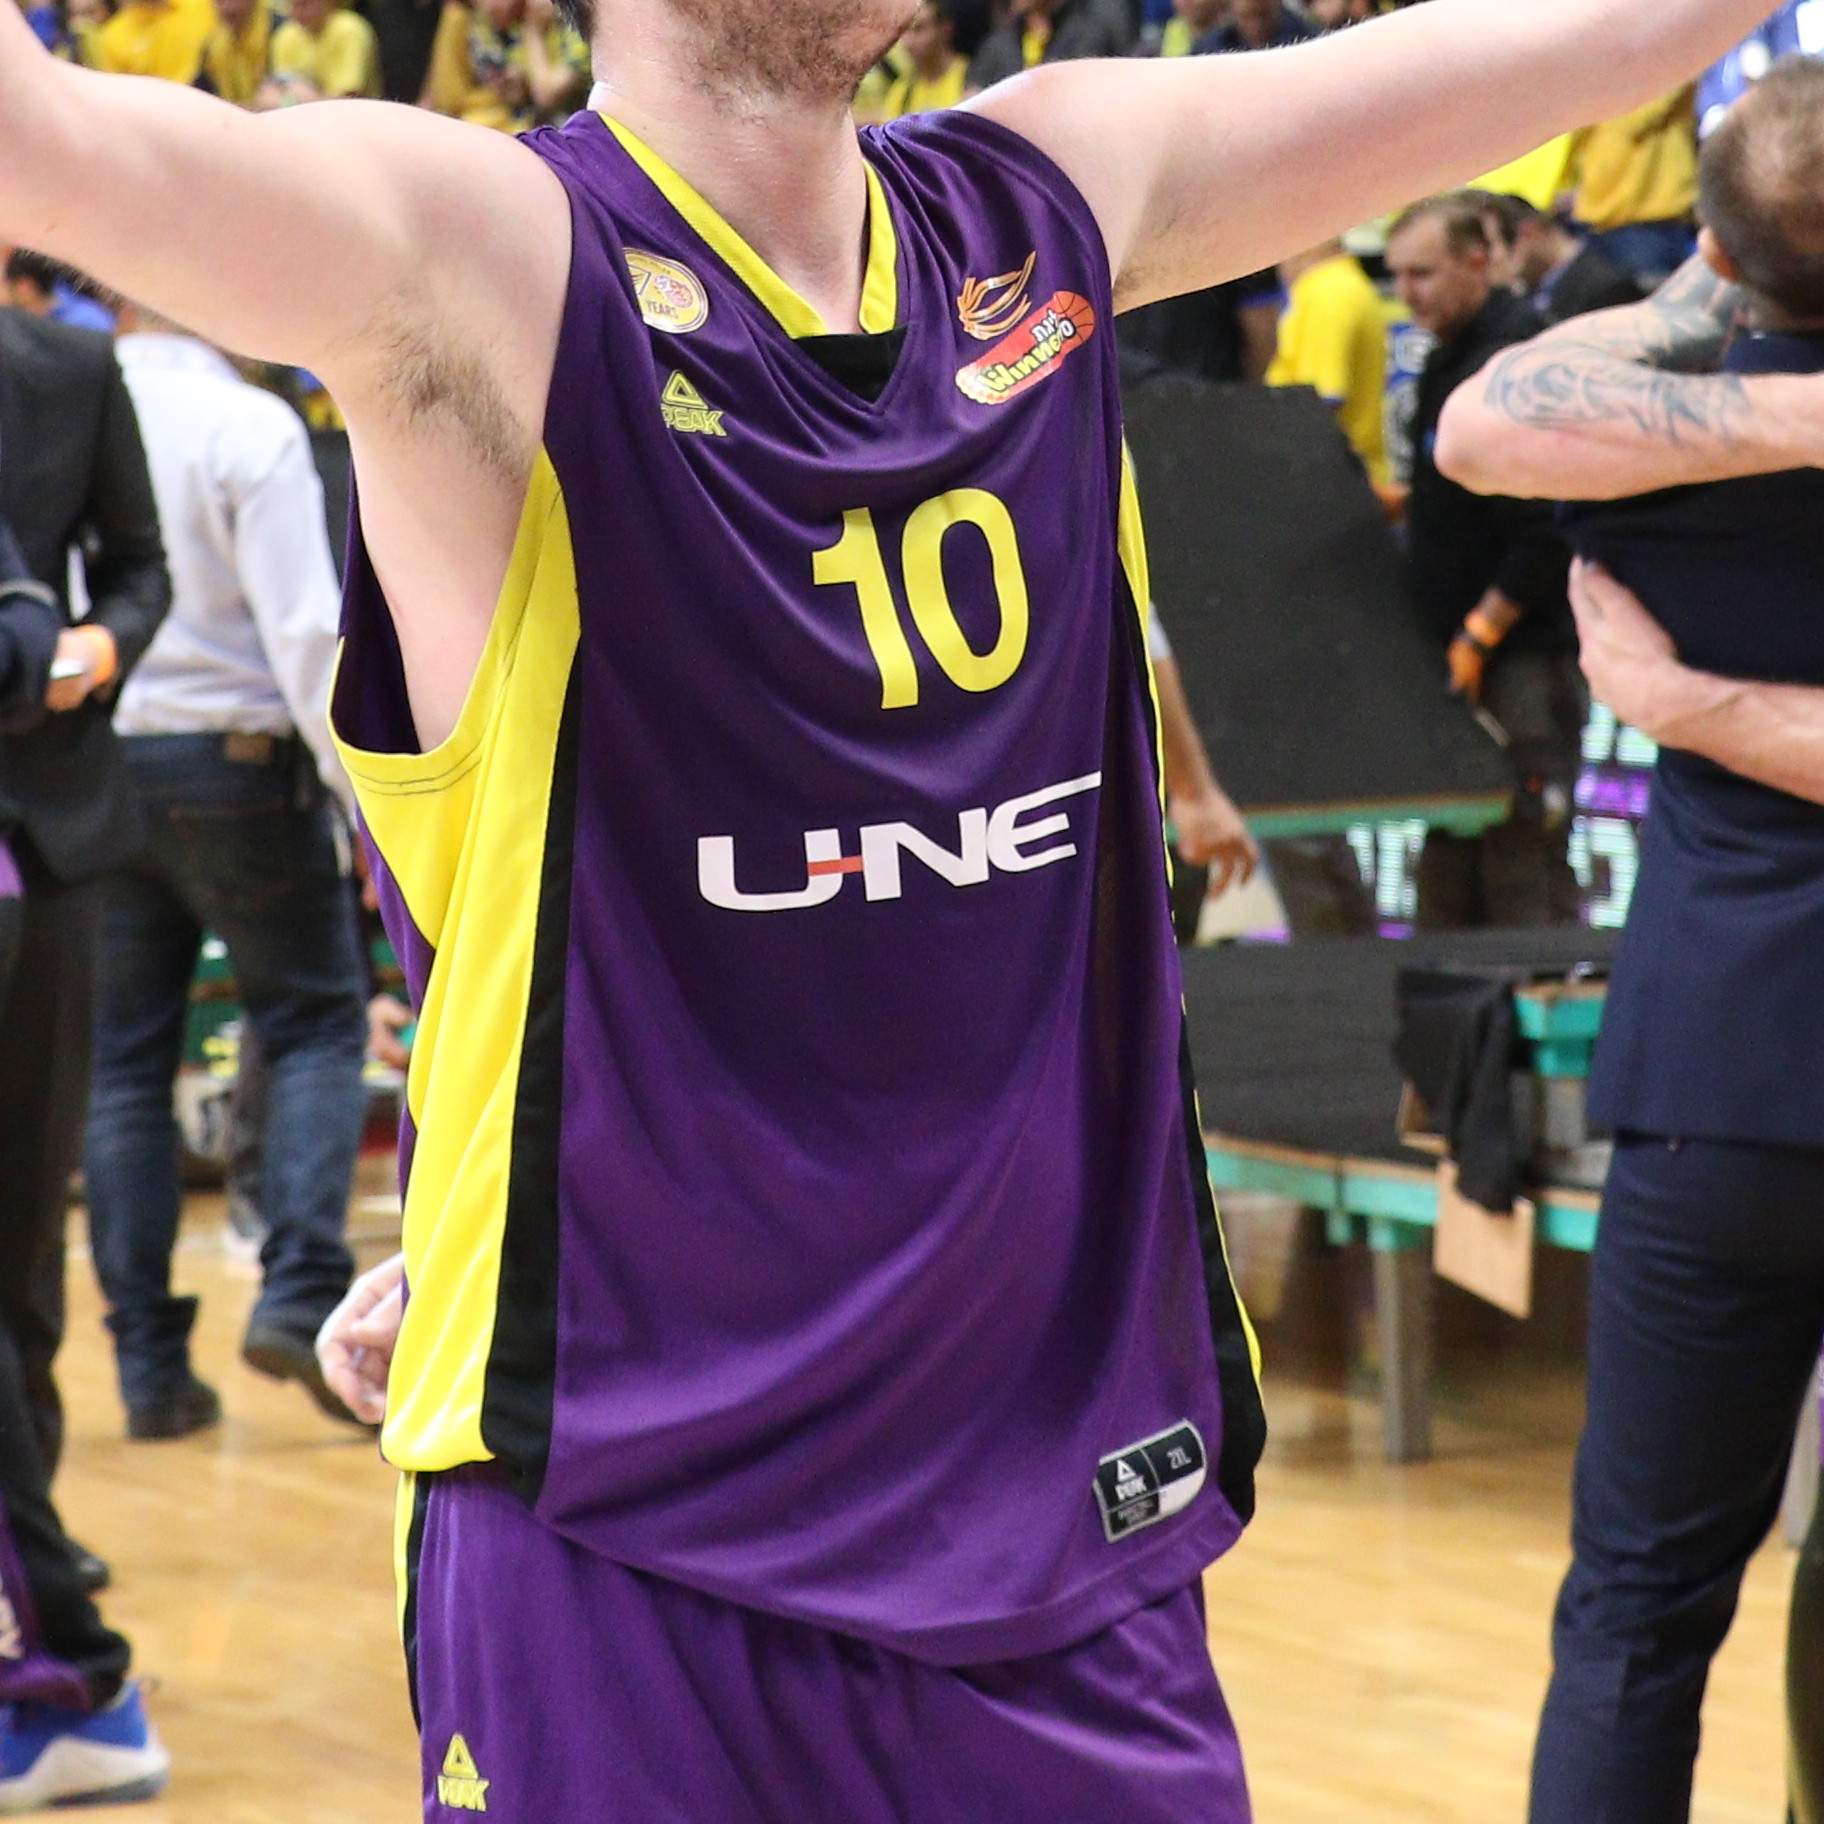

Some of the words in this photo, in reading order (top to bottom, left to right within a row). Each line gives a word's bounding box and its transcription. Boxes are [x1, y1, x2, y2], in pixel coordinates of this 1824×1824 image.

[646, 300, 679, 319] YEARS
[977, 335, 1063, 392] Winne
[660, 404, 727, 437] PEAK
[813, 488, 1030, 711] 10
[695, 770, 1103, 914] UNE
